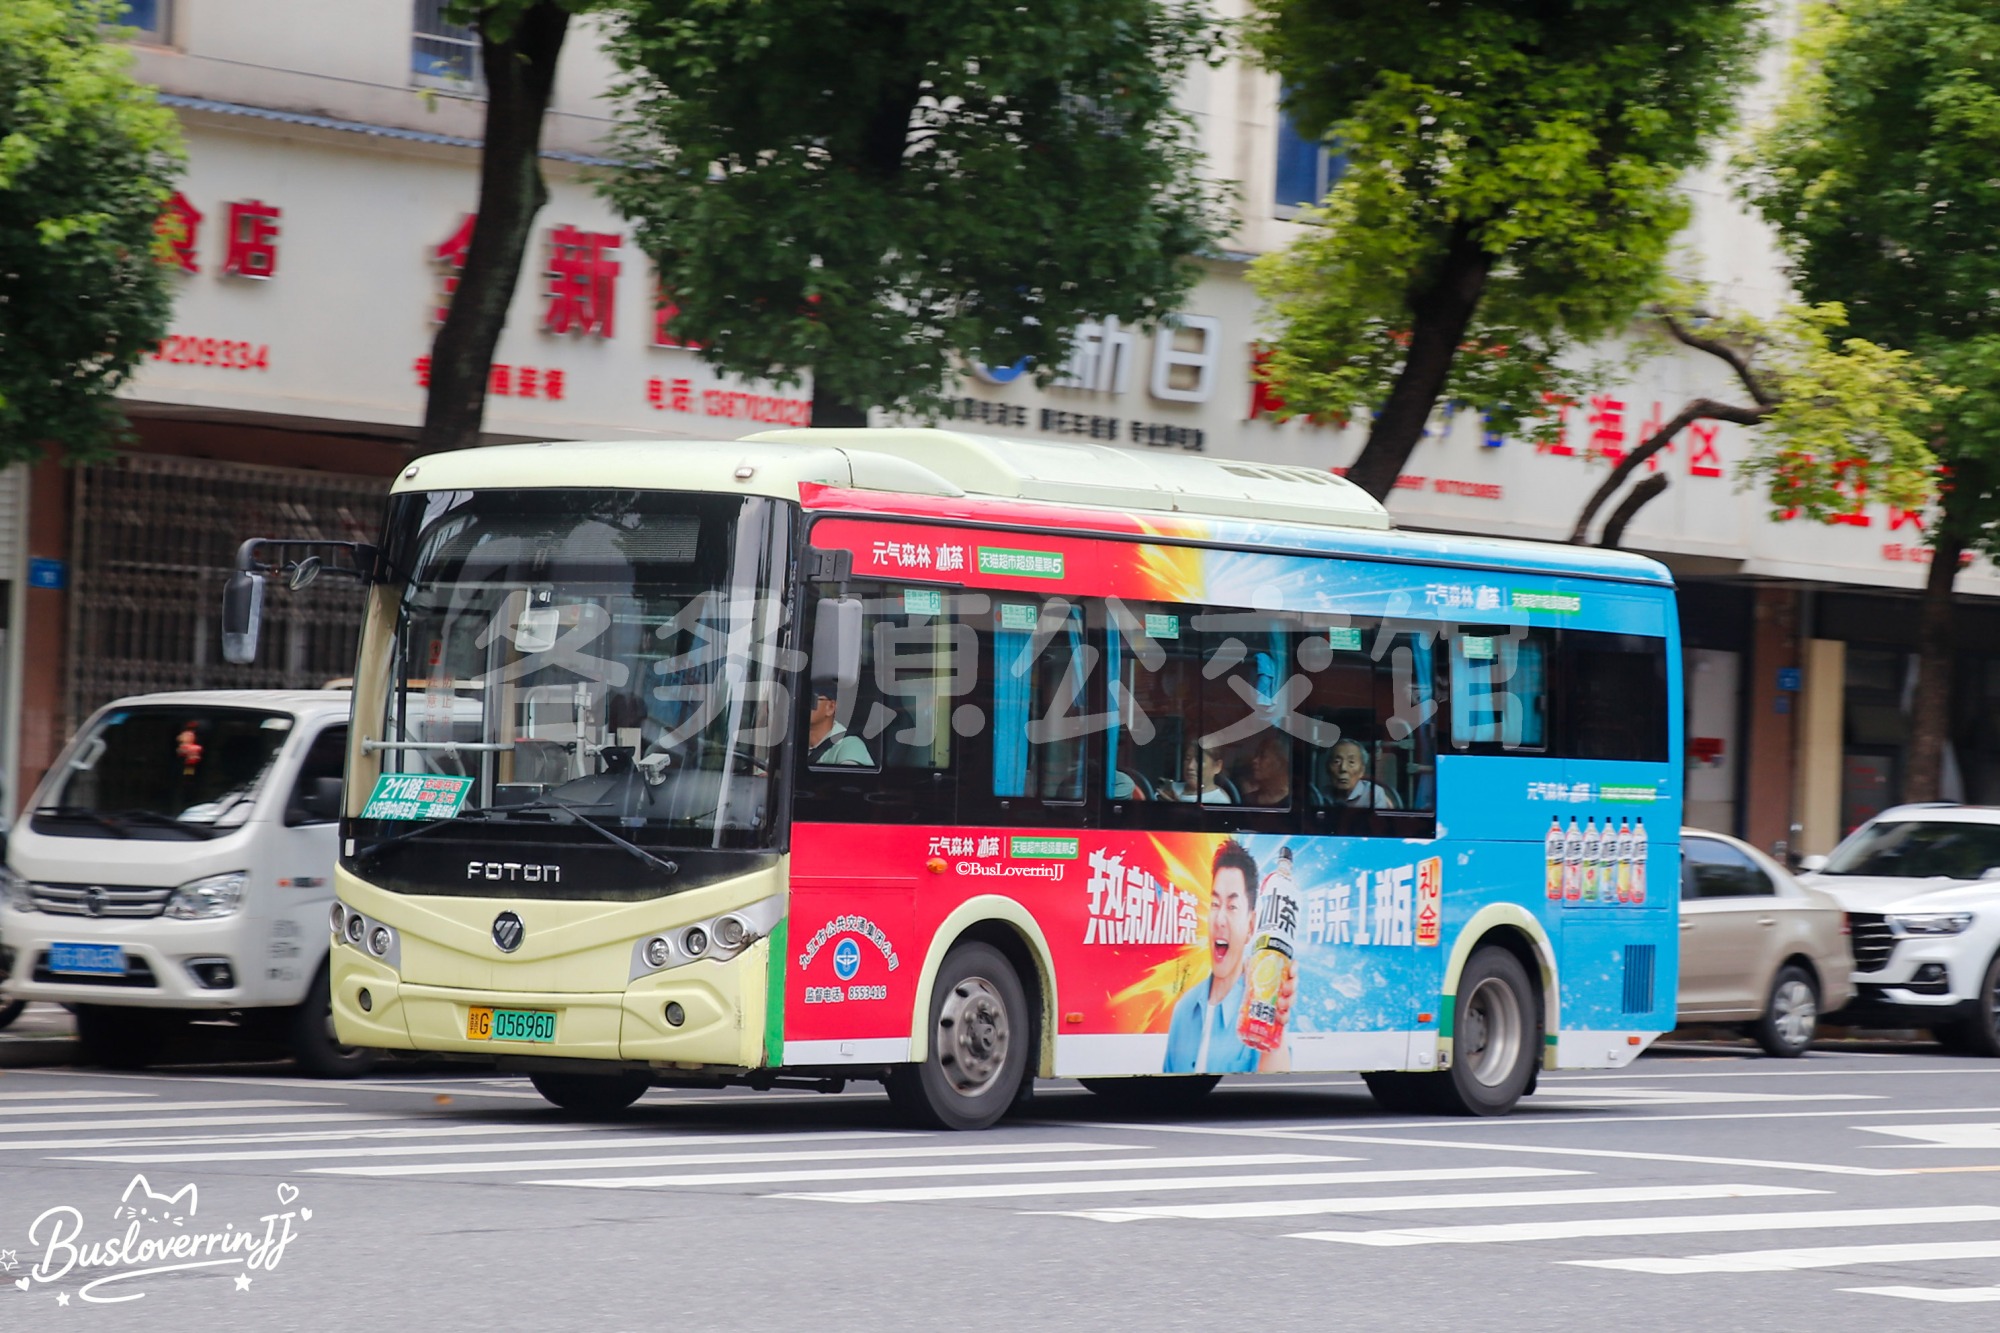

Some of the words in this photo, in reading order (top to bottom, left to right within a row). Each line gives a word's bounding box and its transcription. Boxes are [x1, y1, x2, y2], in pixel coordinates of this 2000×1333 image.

[872, 541, 931, 569] 元气森林
[378, 777, 424, 800] 211路
[928, 837, 974, 856] 元气森林
[467, 861, 560, 882] FOTON
[1083, 846, 1198, 945] 热就冰茶
[1307, 864, 1414, 946] 再来1瓶
[1419, 864, 1438, 939] 礼金
[799, 914, 899, 972] 九江市公共交通集团公司
[848, 985, 887, 1001] 8553416
[496, 1013, 555, 1038] 05696D
